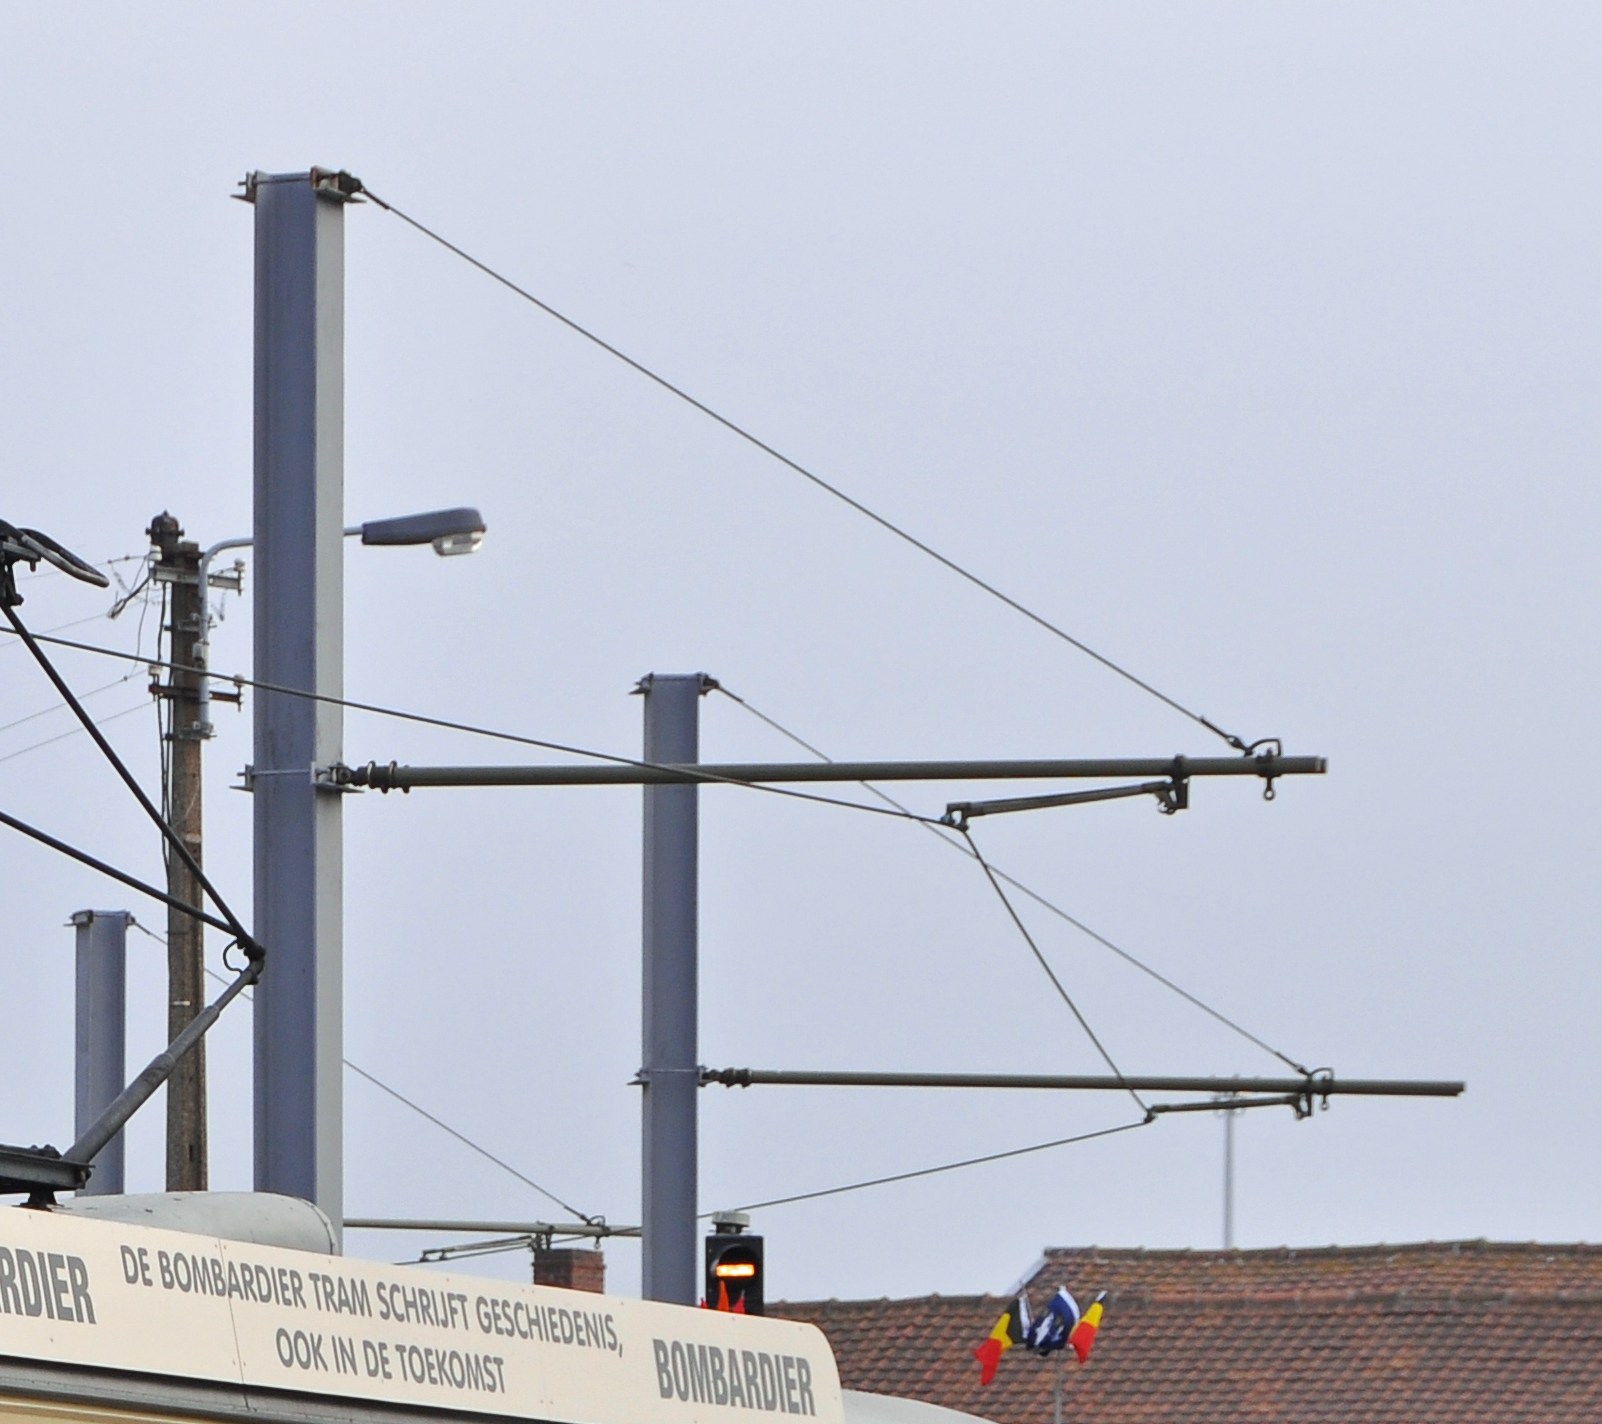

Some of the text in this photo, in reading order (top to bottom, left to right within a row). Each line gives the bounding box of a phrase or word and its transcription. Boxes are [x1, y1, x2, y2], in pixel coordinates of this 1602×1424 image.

[120, 1245, 624, 1359] DE BOMBARDIER TRAM SCHRIJFT GESCHIEDENIS,
[275, 1327, 505, 1394] OOK IN DE TOEKOMST
[652, 1338, 816, 1417] BOMBARDIER
